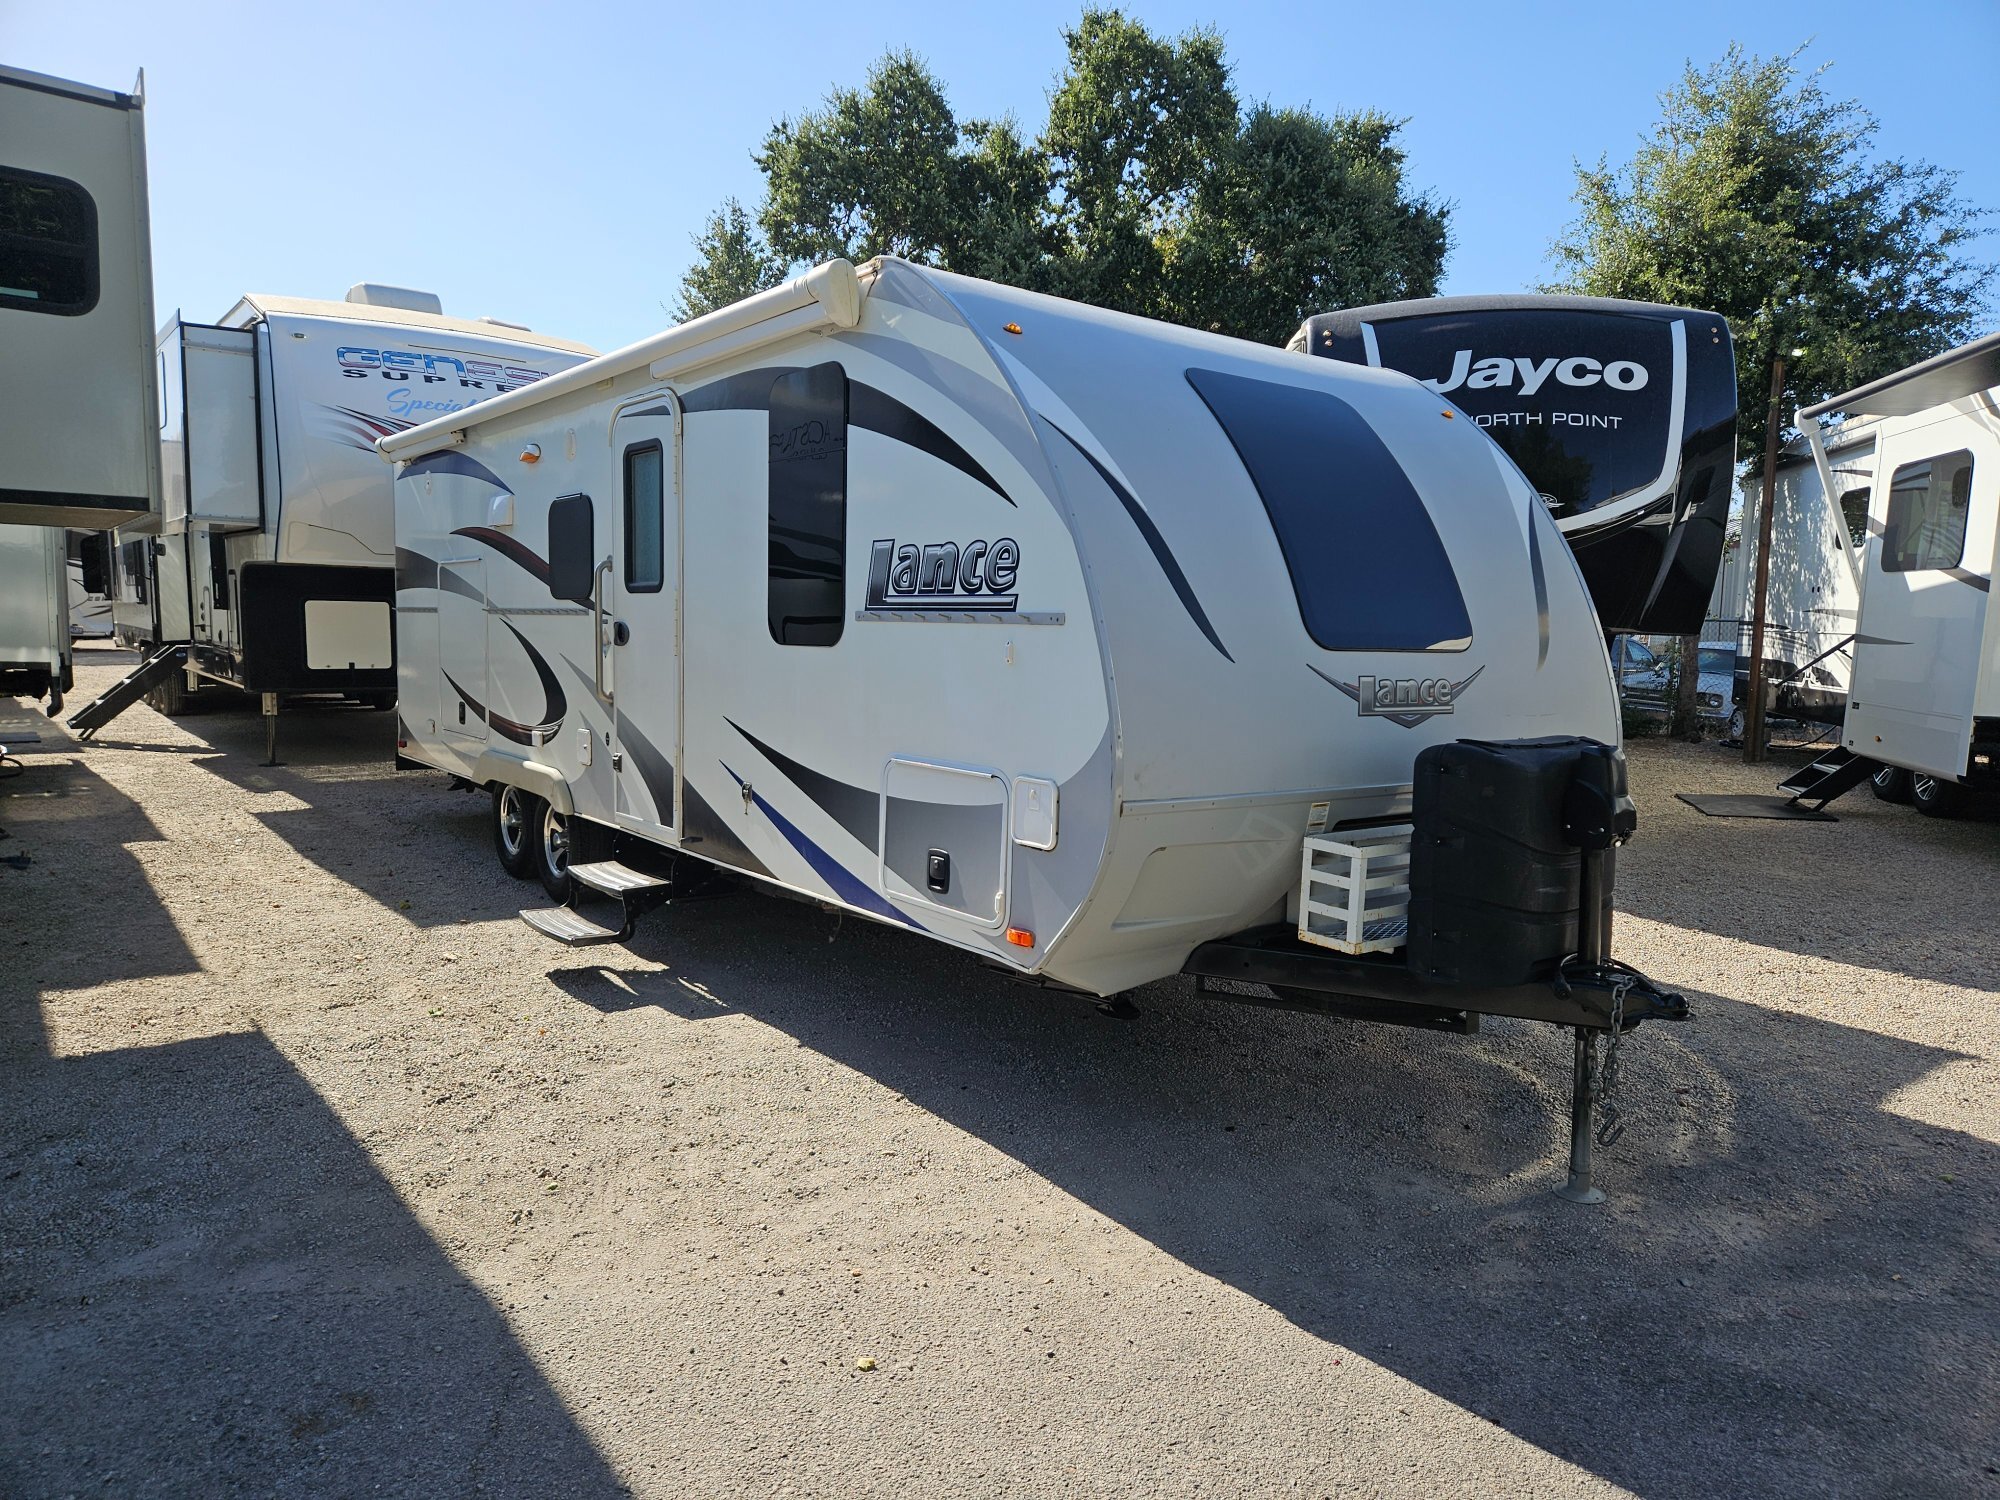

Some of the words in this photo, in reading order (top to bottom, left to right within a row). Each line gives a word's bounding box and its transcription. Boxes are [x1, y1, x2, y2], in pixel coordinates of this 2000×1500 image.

[336, 346, 550, 387] GENES
[1420, 349, 1649, 396] Jayco
[1470, 412, 1543, 427] ORTH
[1552, 412, 1623, 430] POINT
[865, 537, 1020, 612] Lance
[1358, 675, 1454, 717] Lance
